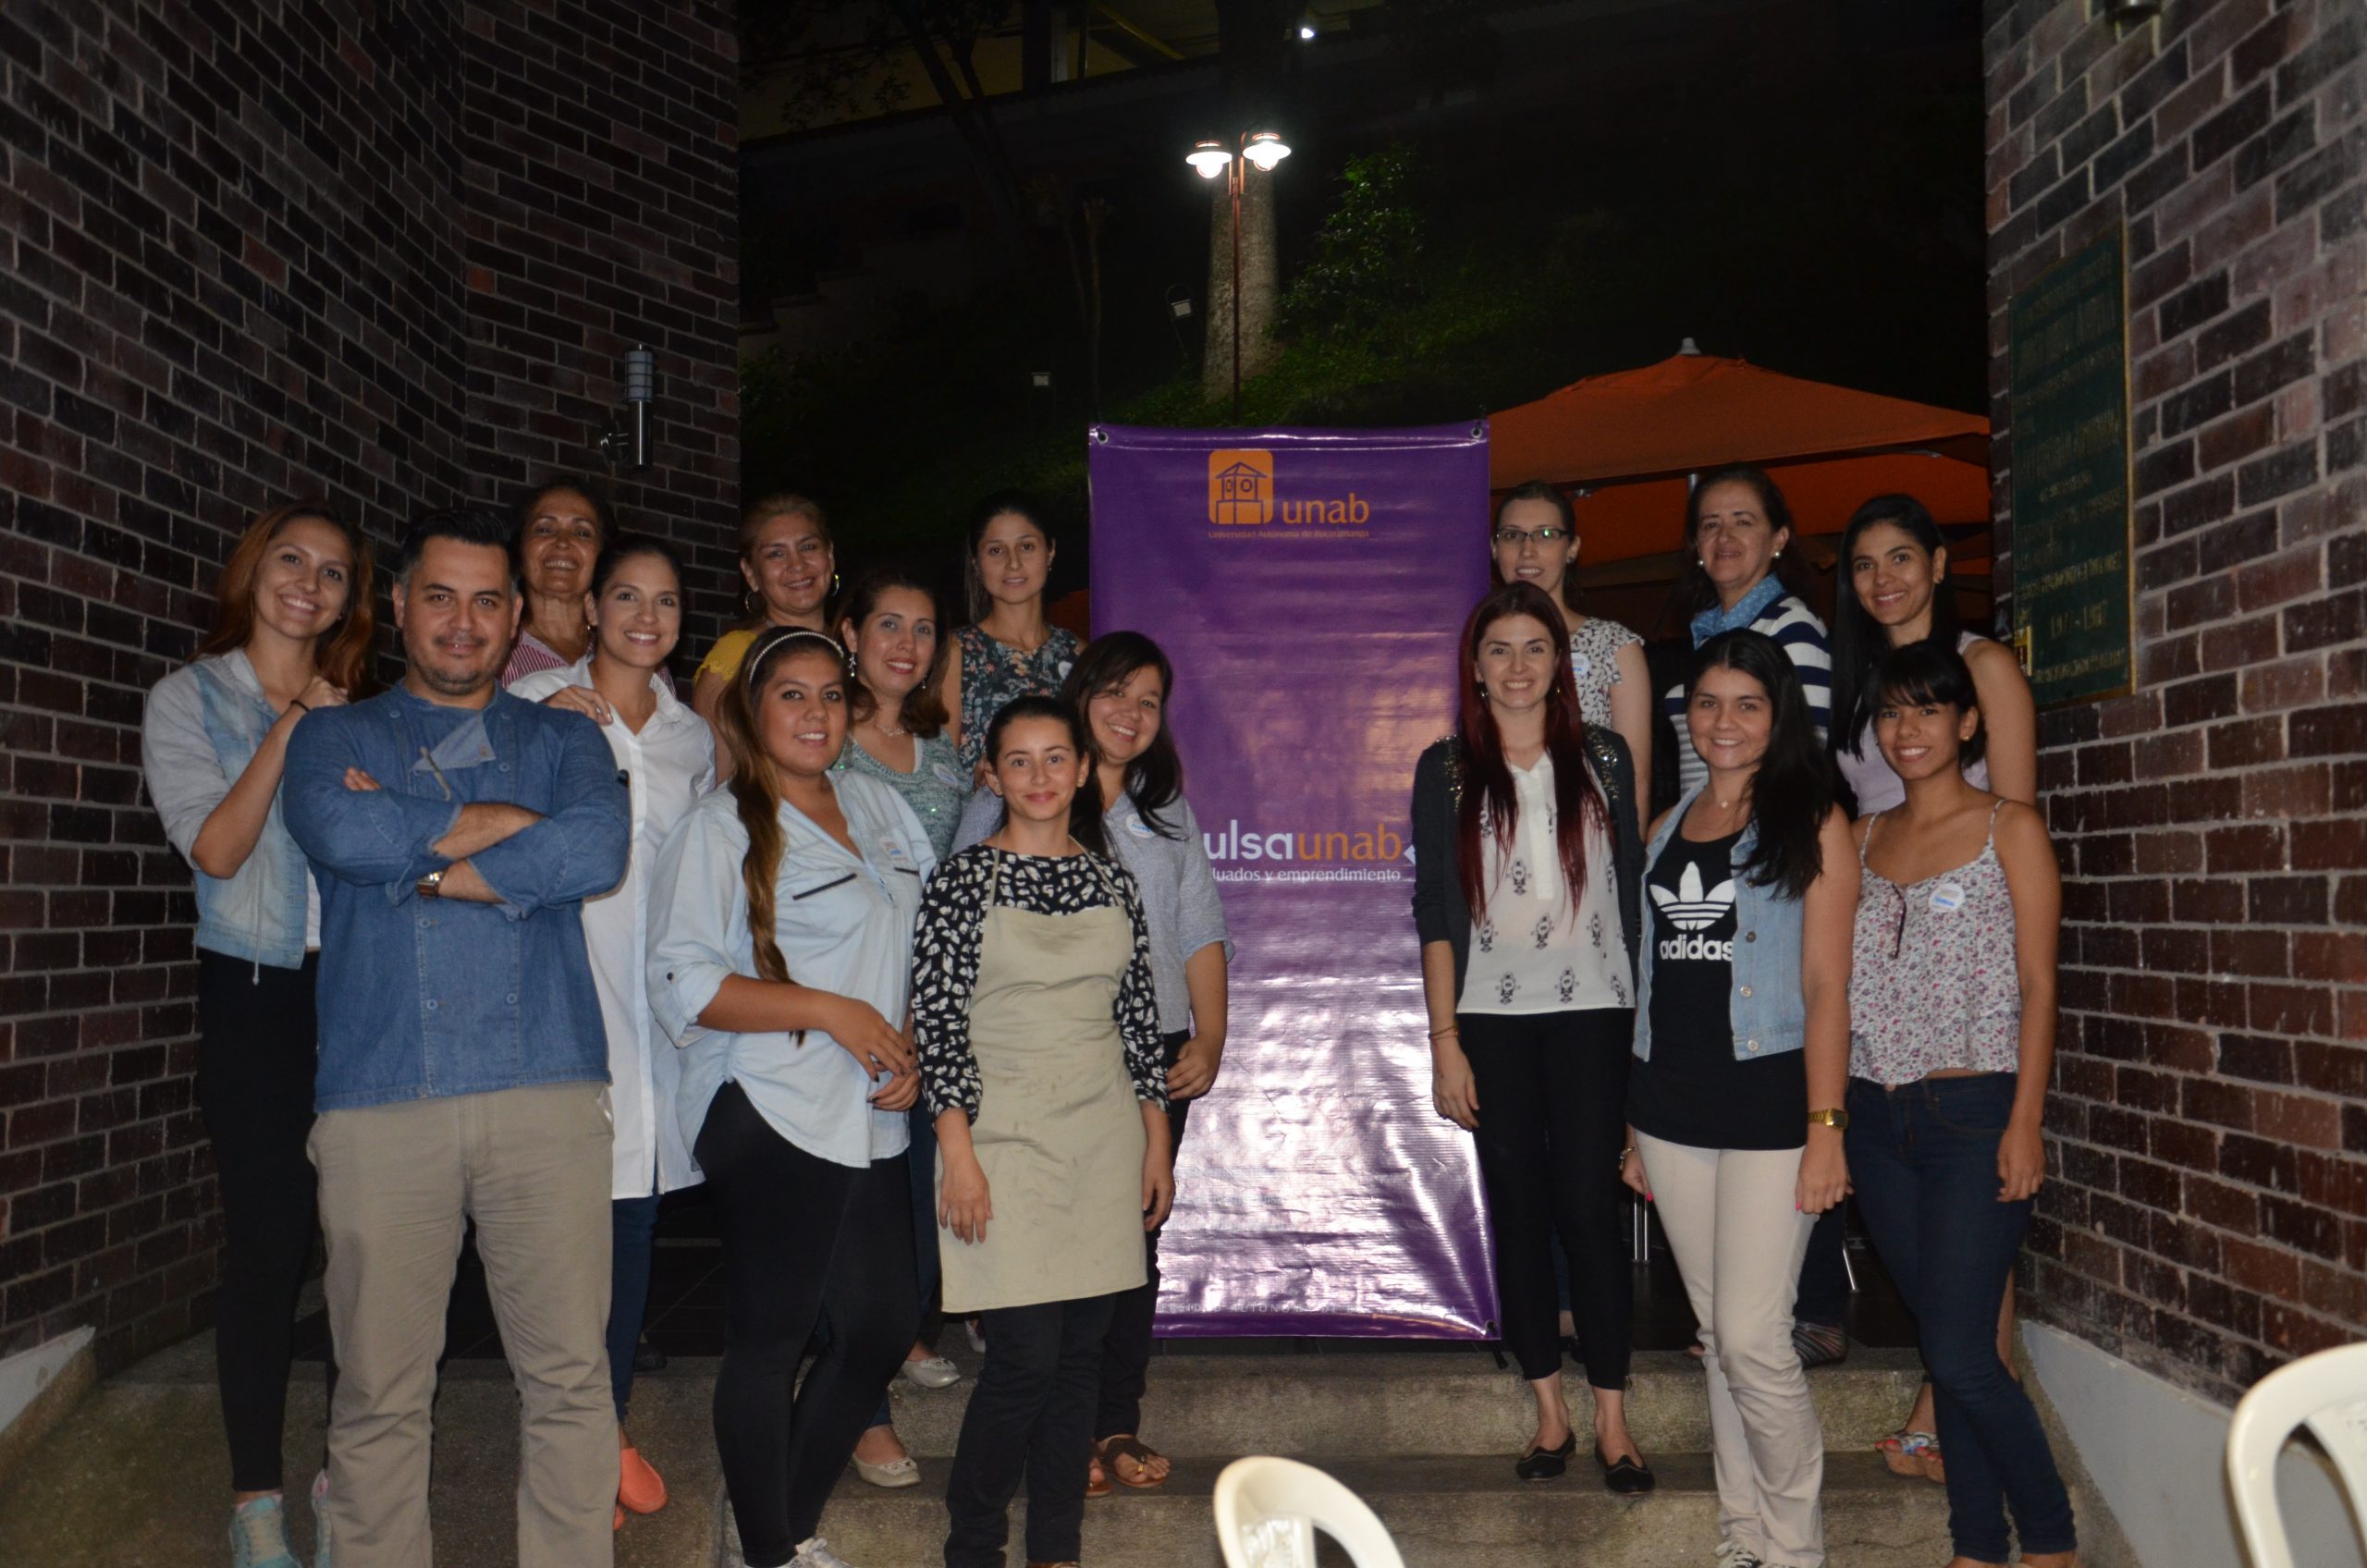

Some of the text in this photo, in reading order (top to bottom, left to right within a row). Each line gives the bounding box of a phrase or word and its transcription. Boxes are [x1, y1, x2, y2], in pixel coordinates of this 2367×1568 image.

[1282, 492, 1369, 524] unab
[1208, 530, 1256, 539] Universidad
[1301, 530, 1313, 538] de
[1204, 819, 1402, 861] ulsaunab
[1265, 871, 1274, 884] y
[1279, 867, 1401, 884] emprendimiento
[1660, 934, 1734, 961] adidas
